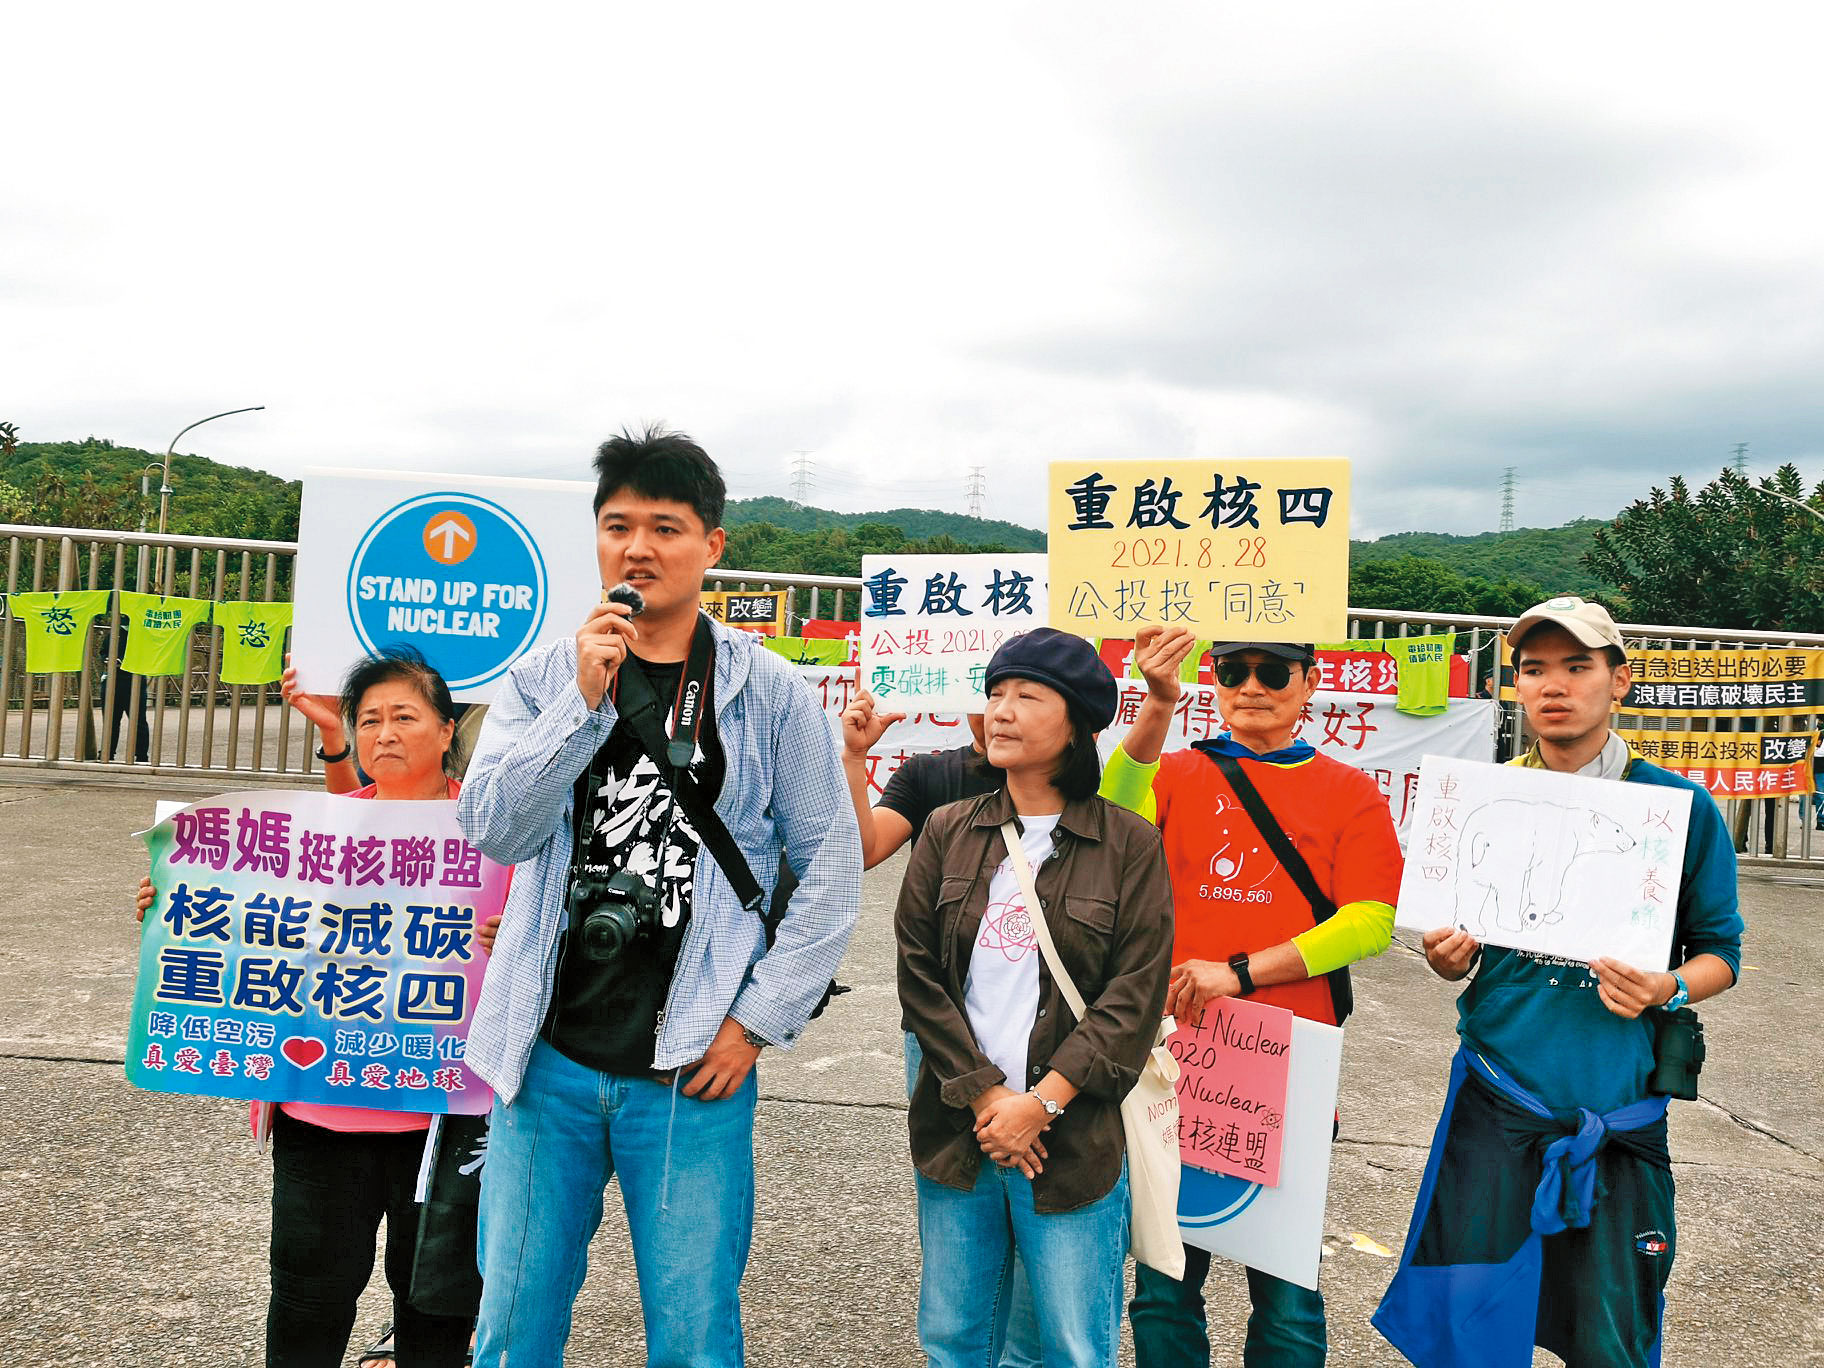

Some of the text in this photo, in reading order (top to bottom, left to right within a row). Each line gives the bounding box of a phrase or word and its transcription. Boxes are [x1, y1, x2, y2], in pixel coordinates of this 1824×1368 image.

[1065, 472, 1333, 530] 重啟核四
[359, 576, 533, 610] STAND UP FOR
[863, 568, 1048, 617] 重啟核
[1068, 579, 1305, 624] 公投投「同意」
[41, 607, 76, 635] 怒
[238, 620, 270, 648] 怒
[387, 606, 500, 638] NUCLEAR
[871, 628, 935, 656] 公投
[1628, 656, 1807, 678] 有急迫送出的必要
[680, 680, 701, 727] Canon
[1634, 683, 1806, 706] 浪費百億破壞民主
[1672, 769, 1797, 792] 是人民作主
[1199, 884, 1273, 904] 5,895,560
[163, 884, 474, 960] 核能減碳
[156, 948, 466, 1022] 重啟核四
[148, 1012, 276, 1047] 降低空污
[336, 1029, 466, 1061] 減少暖化
[1212, 1009, 1290, 1058] Nuclear
[142, 1044, 276, 1079] 真愛臺灣
[1159, 1037, 1217, 1070] 020
[328, 1061, 467, 1092] 真愛地球
[1179, 1074, 1266, 1115] Nuclear
